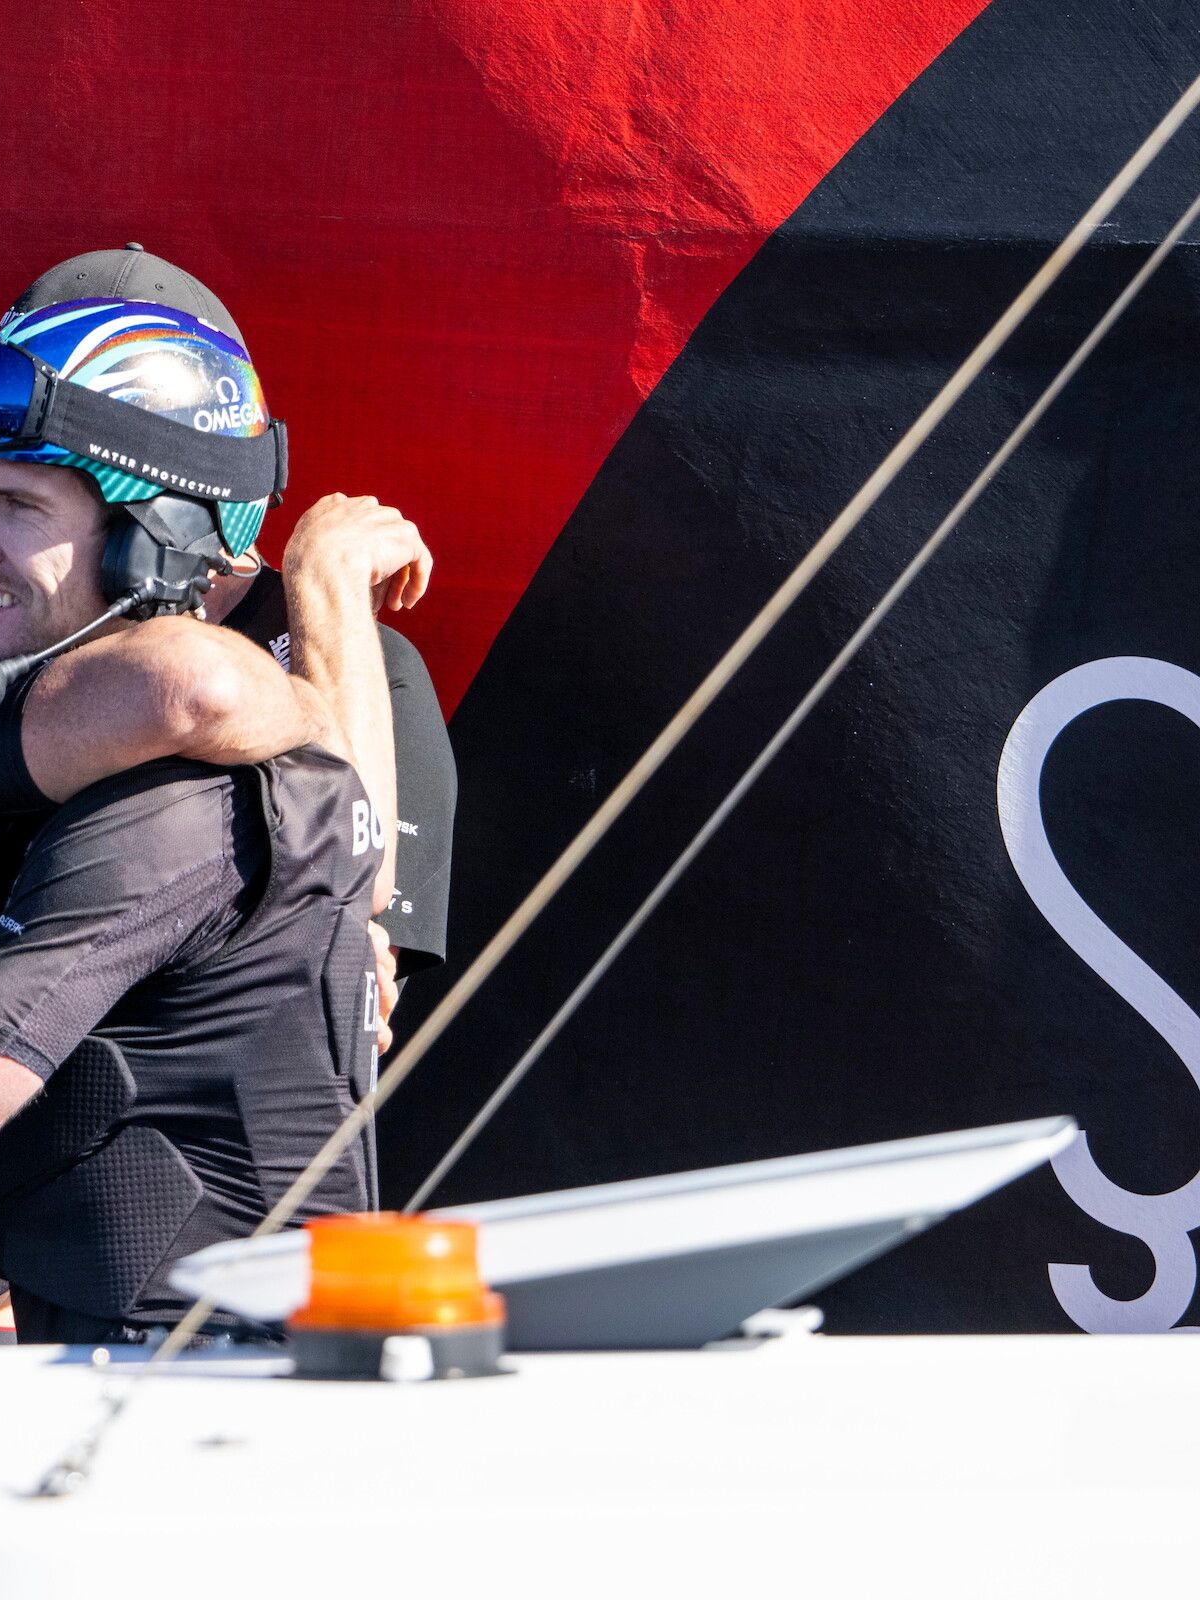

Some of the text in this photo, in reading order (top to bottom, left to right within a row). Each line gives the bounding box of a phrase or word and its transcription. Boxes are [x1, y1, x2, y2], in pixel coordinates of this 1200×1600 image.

[193, 403, 265, 432] OMEGA
[89, 443, 232, 498] WATER PROTECTION
